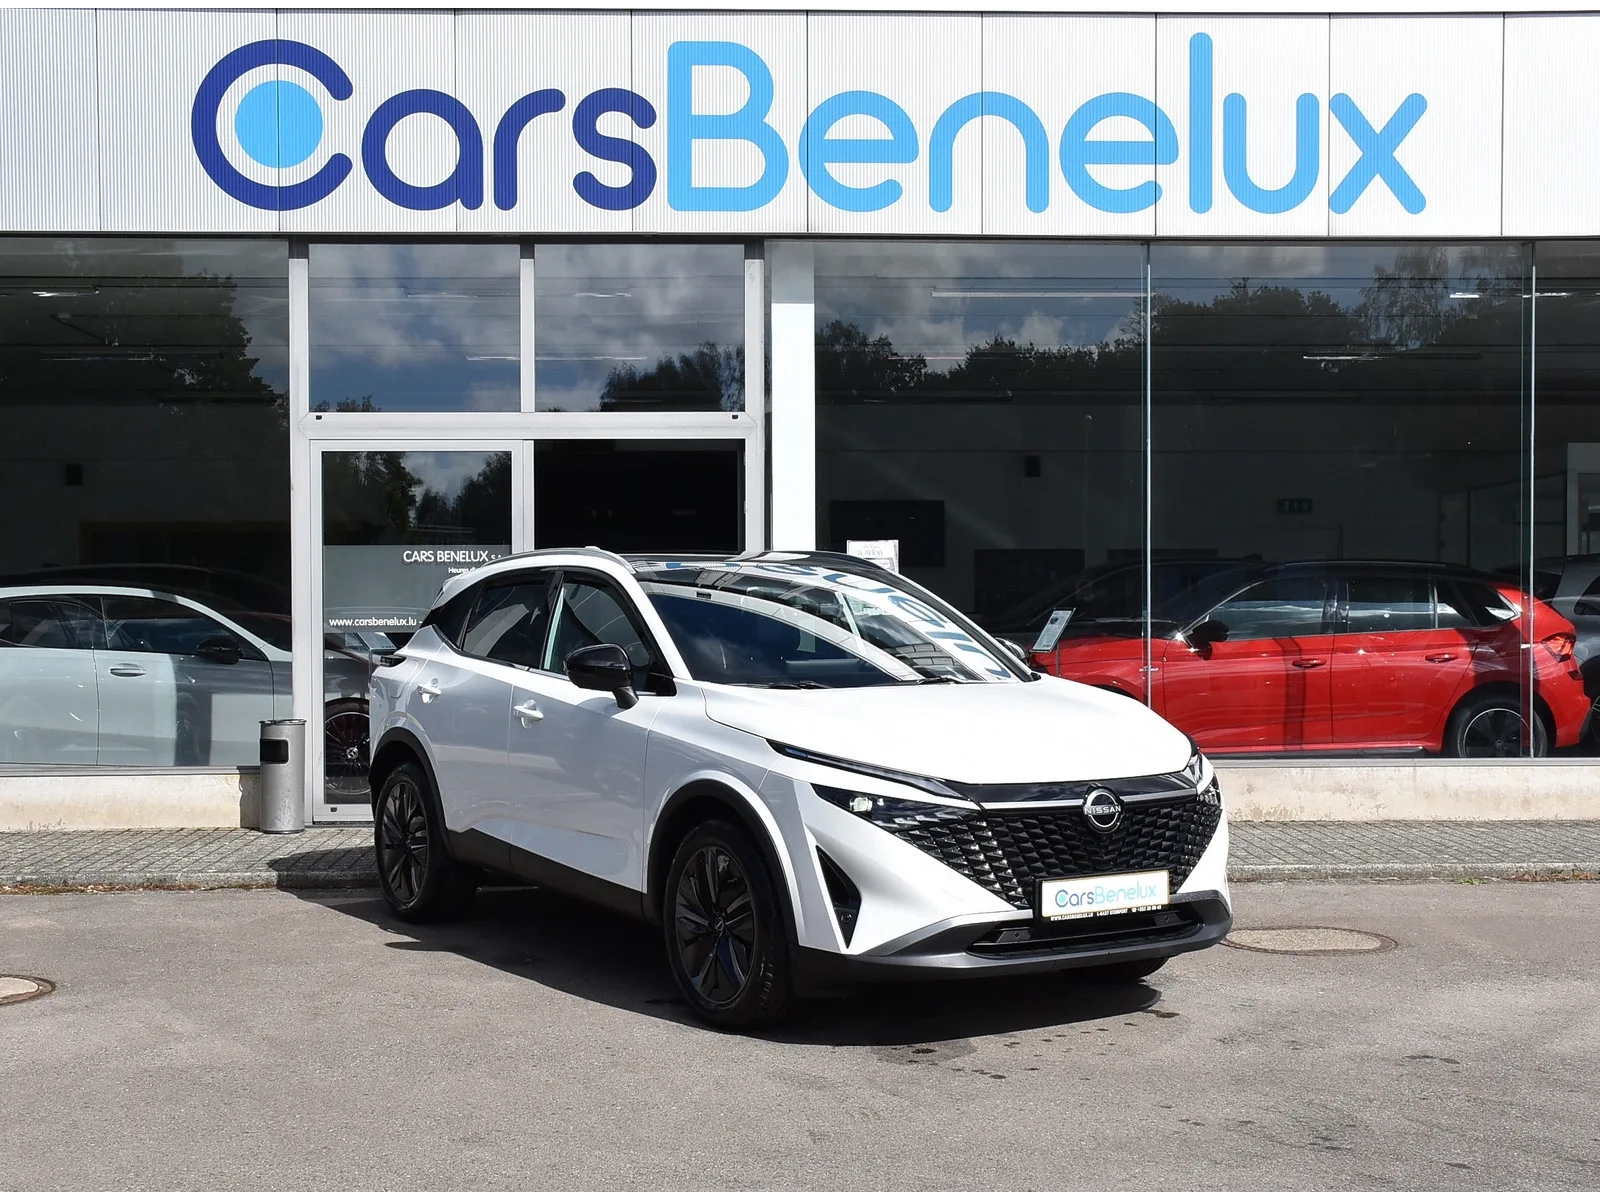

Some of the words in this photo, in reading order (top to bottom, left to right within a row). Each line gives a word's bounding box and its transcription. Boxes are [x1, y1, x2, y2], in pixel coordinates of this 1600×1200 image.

[191, 32, 1427, 214] CarsBenelux
[403, 550, 434, 563] CARS
[437, 550, 489, 562] BENELUX
[329, 617, 417, 627] www.carsbenelux.lu
[1084, 805, 1121, 815] NISSAN
[1055, 881, 1157, 908] CarsBenelux
